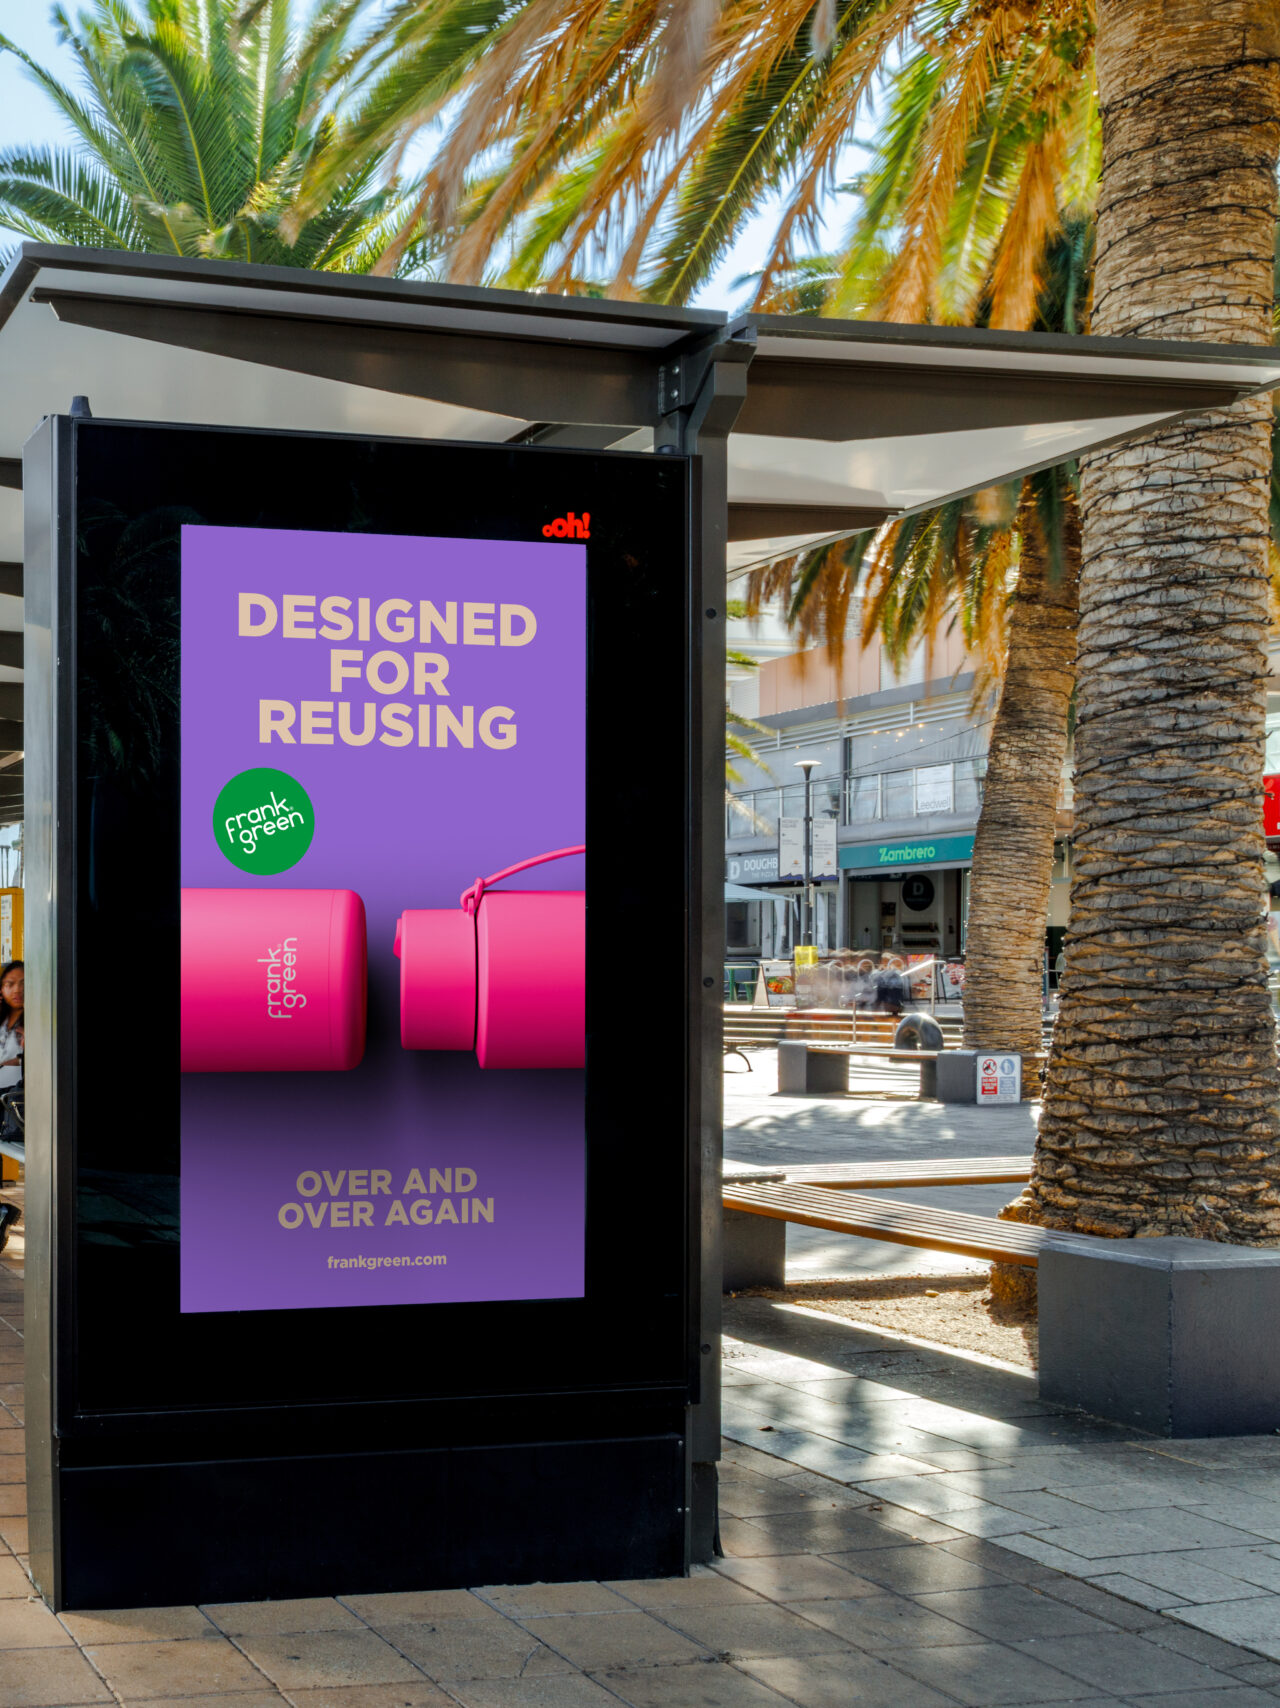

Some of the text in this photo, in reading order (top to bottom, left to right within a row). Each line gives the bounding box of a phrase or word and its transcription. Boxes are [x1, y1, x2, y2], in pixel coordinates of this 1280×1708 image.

[238, 592, 538, 647] DESIGNED
[330, 649, 450, 696] FOR
[259, 699, 517, 750] REUSING
[239, 811, 305, 854] green
[729, 861, 740, 880] D
[879, 846, 935, 862] Zambrero
[283, 937, 307, 1008] green
[296, 1167, 478, 1197] OVER AND
[278, 1198, 495, 1229] OVER AGAIN
[327, 1254, 447, 1270] frankgreen.com
